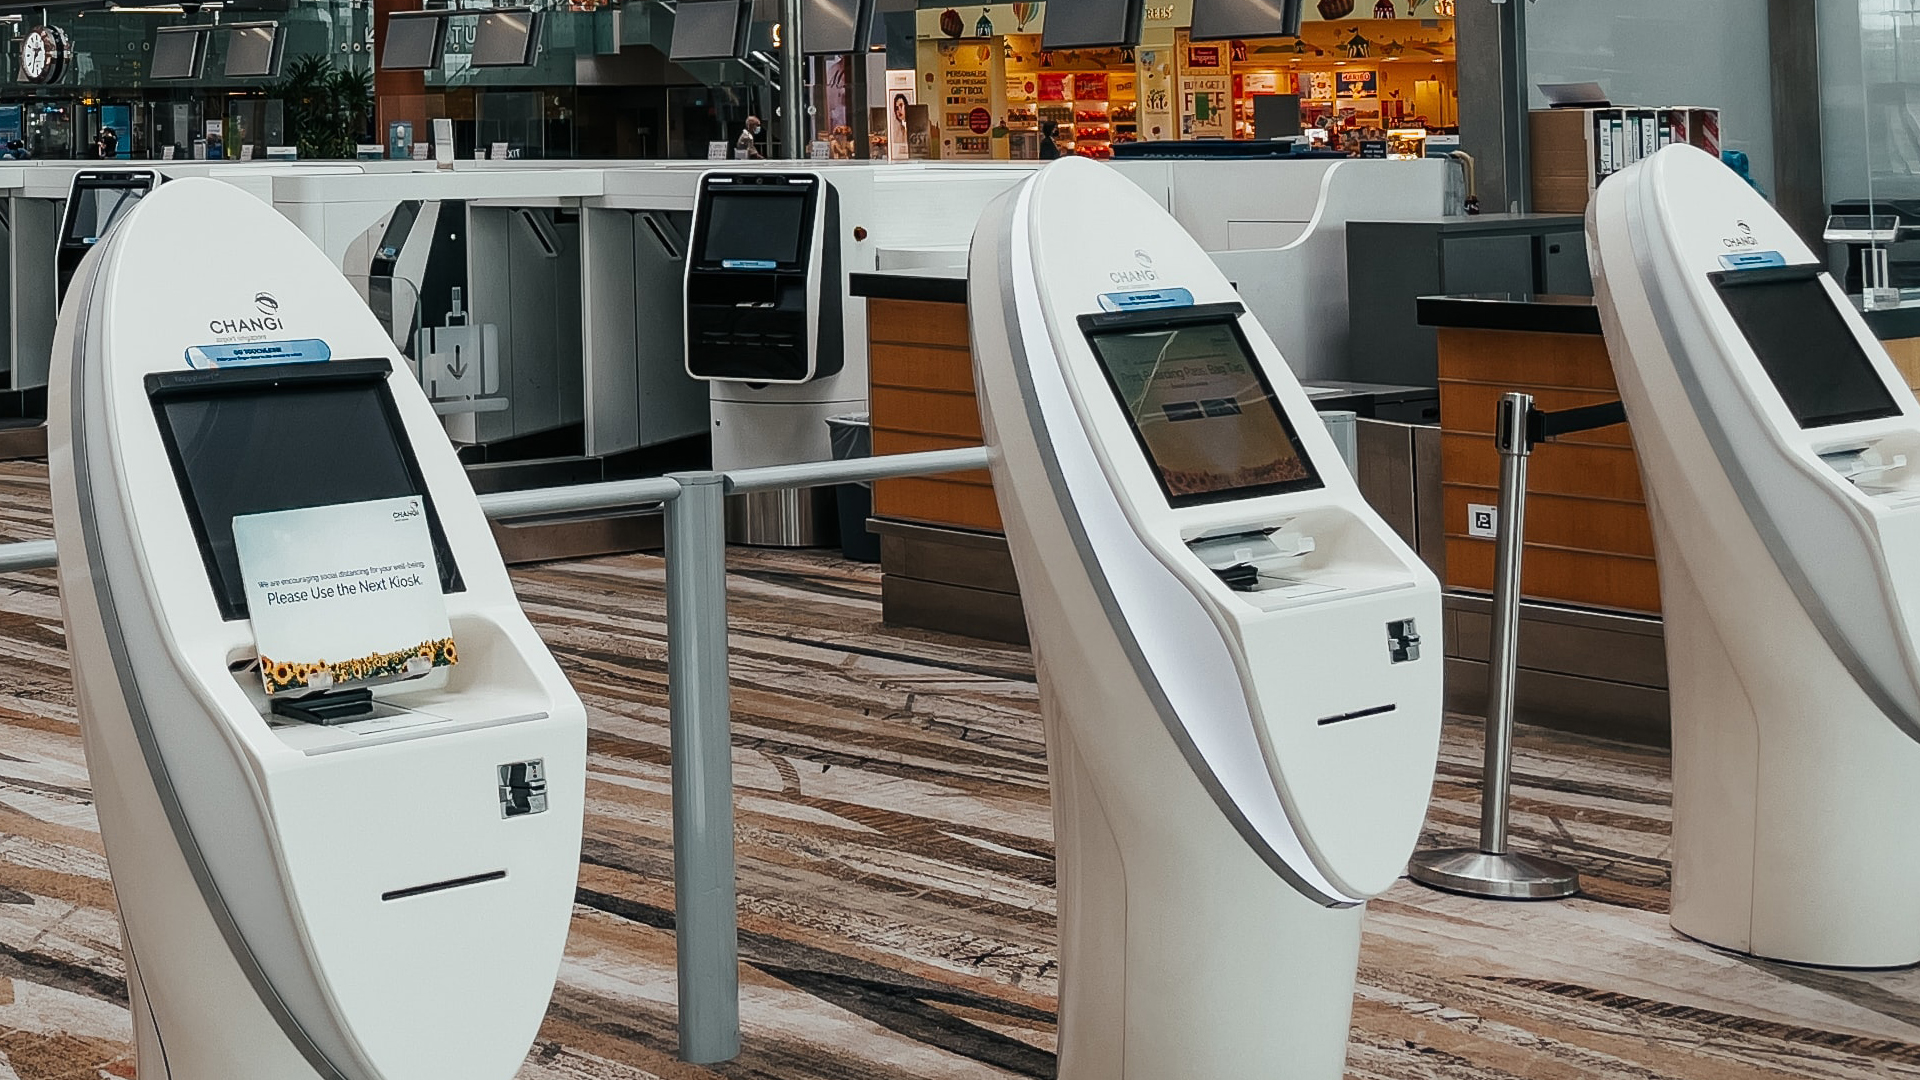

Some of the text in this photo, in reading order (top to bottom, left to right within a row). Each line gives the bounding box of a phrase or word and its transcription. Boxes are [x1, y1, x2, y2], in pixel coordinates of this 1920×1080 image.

[1144, 8, 1170, 19] REES
[507, 149, 520, 158] XIT
[1723, 236, 1759, 248] CHANGI
[1109, 270, 1160, 283] CHANGI
[210, 317, 284, 334] CHANGI
[281, 575, 320, 586] encouraging
[339, 568, 370, 578] distancing
[267, 573, 423, 605] Please Use the Next Kiosk.
